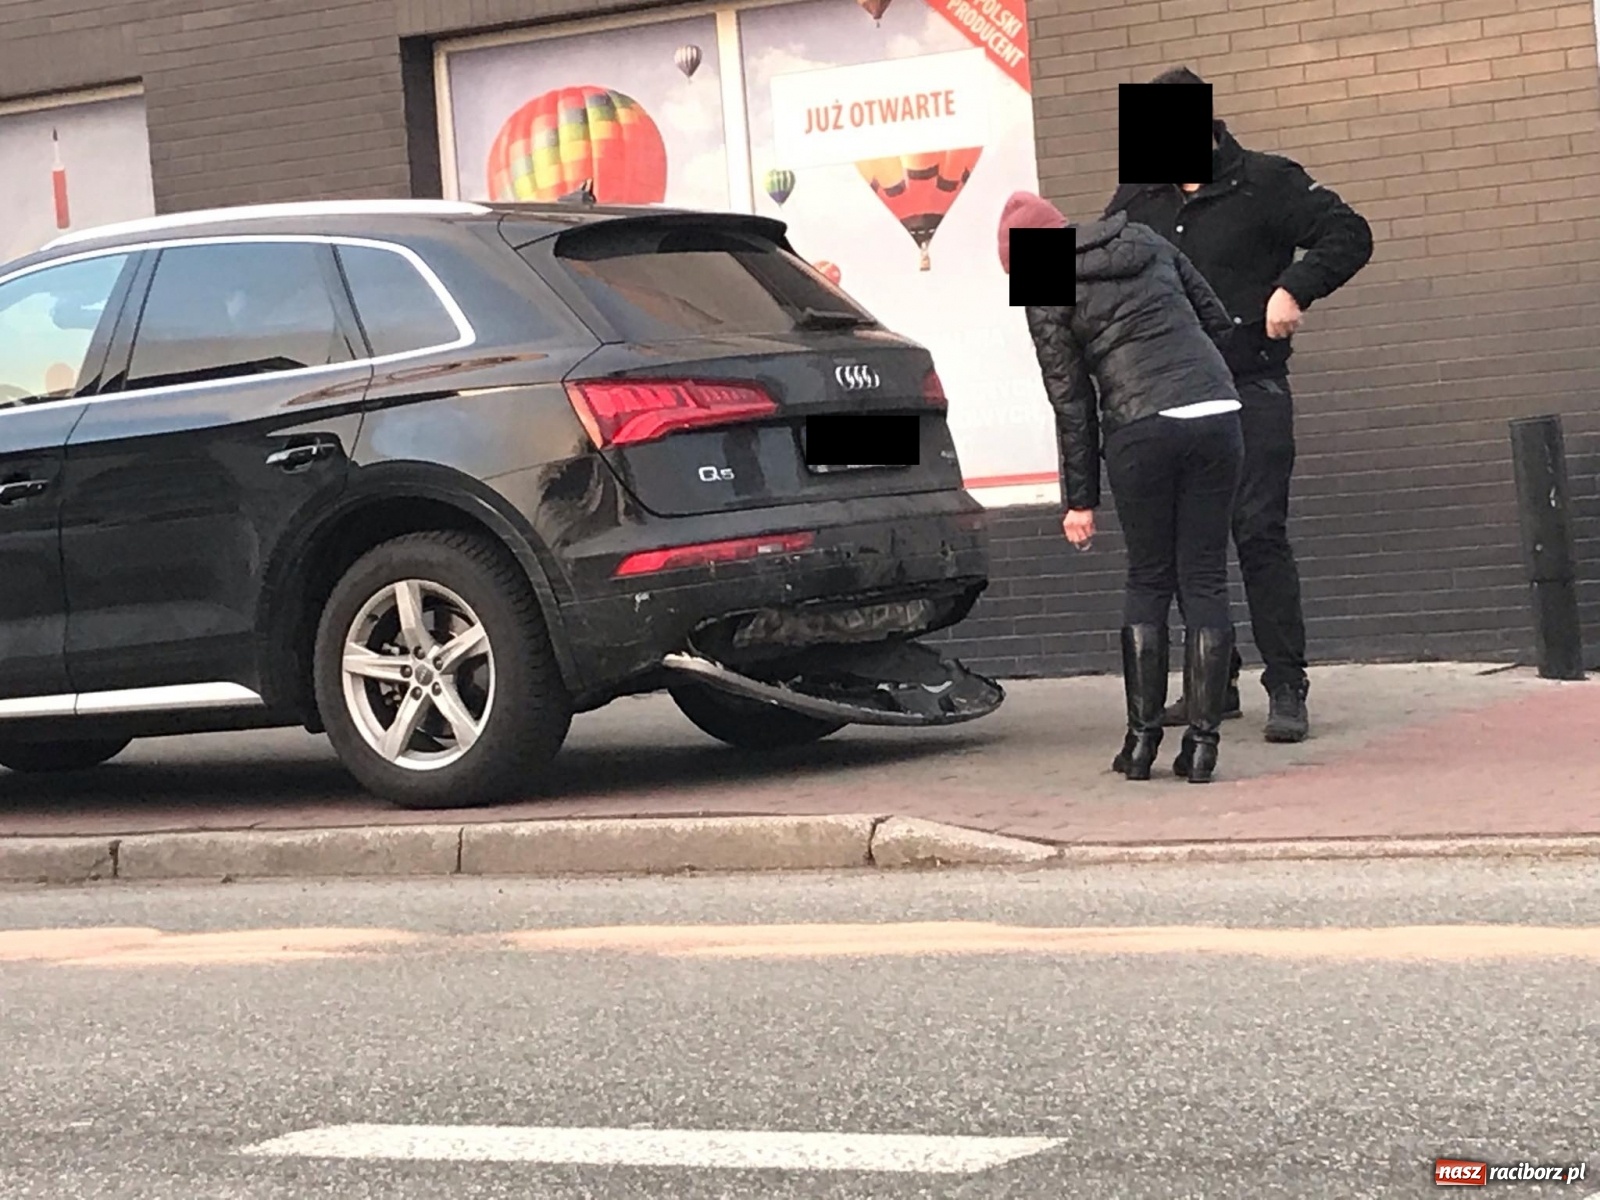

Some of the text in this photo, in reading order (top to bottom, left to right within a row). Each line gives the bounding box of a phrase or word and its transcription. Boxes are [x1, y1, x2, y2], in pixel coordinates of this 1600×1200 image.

[804, 89, 956, 135] JUŻ OTWARTE
[698, 466, 736, 482] Q5
